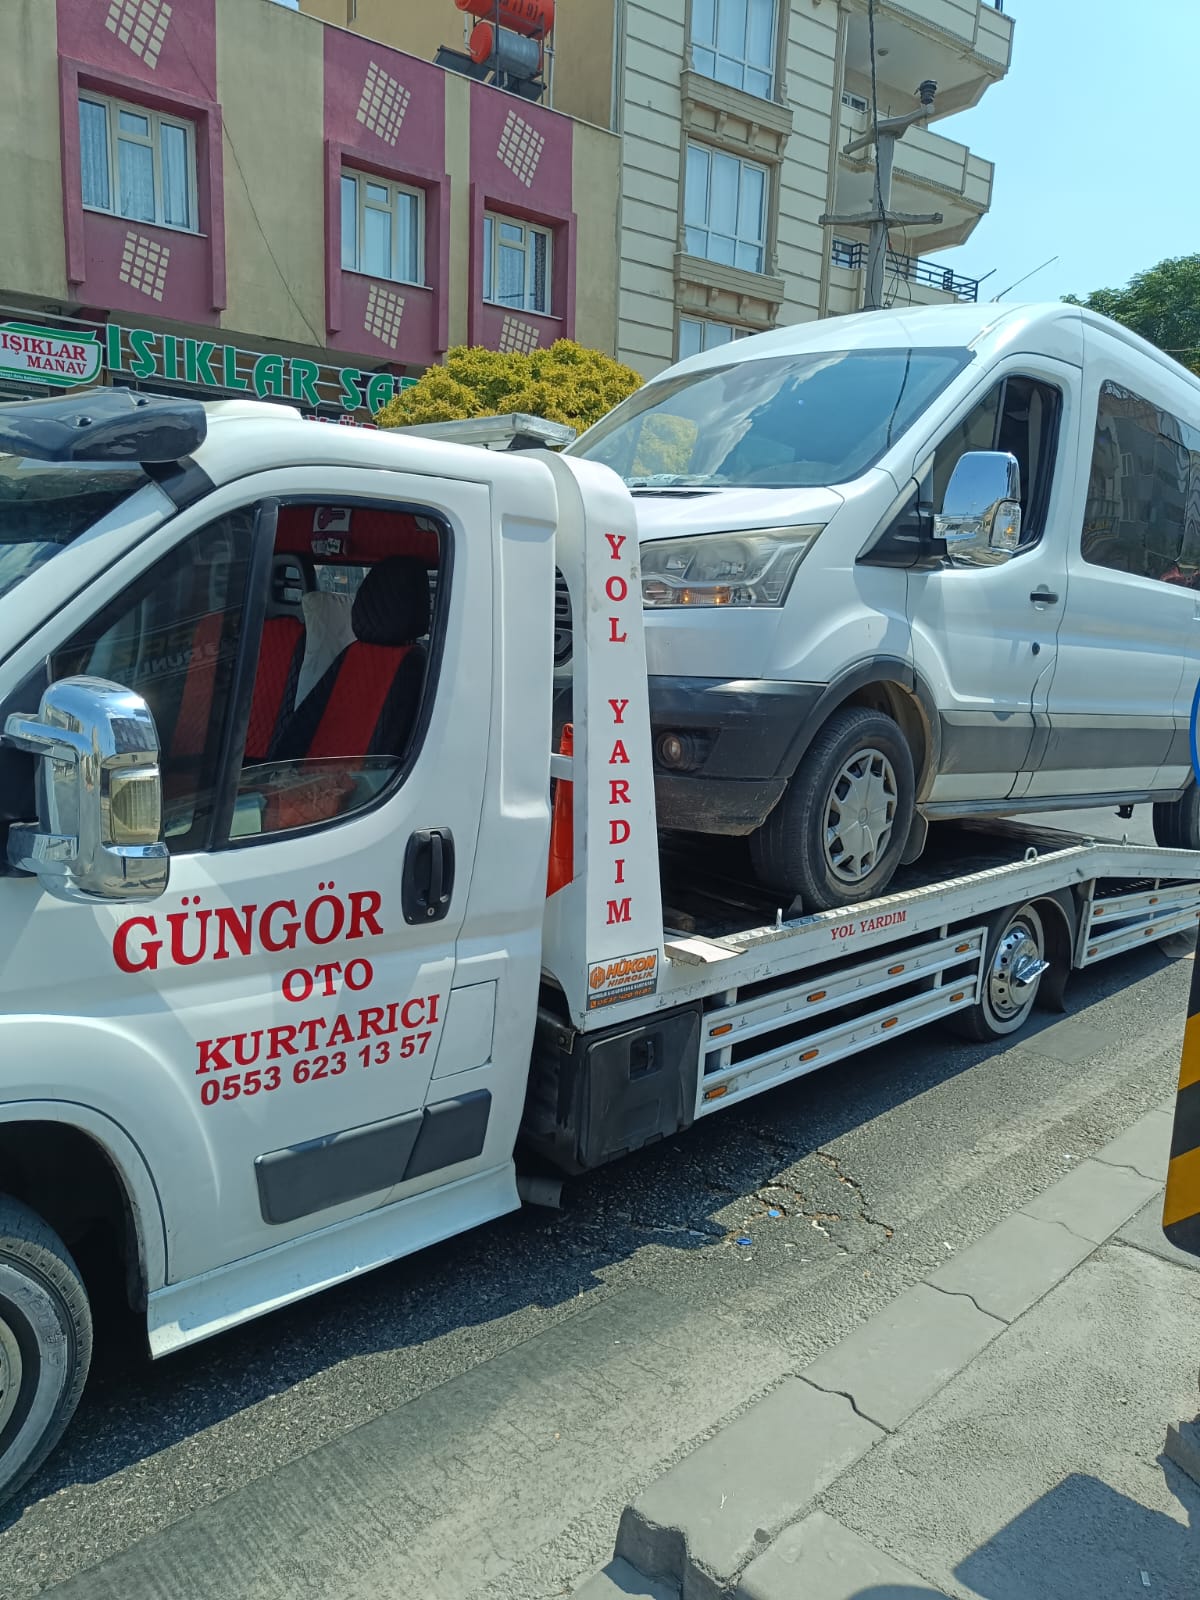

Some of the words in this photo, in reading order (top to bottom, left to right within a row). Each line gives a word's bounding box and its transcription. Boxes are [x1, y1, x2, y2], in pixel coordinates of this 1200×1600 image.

[1, 333, 87, 362] IŞIKLAR
[27, 355, 87, 375] MANAV
[106, 324, 321, 408] IŞIKLAR
[605, 533, 628, 643] YOL
[605, 699, 632, 925] YARDIM
[112, 881, 384, 974] GÜNGÖR
[831, 924, 856, 940] YOL
[860, 910, 906, 933] YARDIM
[282, 958, 374, 1002] OTO
[606, 955, 656, 979] HÜKON
[195, 994, 440, 1075] KURTARICI
[200, 1066, 281, 1106] 0553
[293, 1051, 348, 1084] 623
[358, 1041, 390, 1068] 13
[399, 1031, 432, 1059] 57
